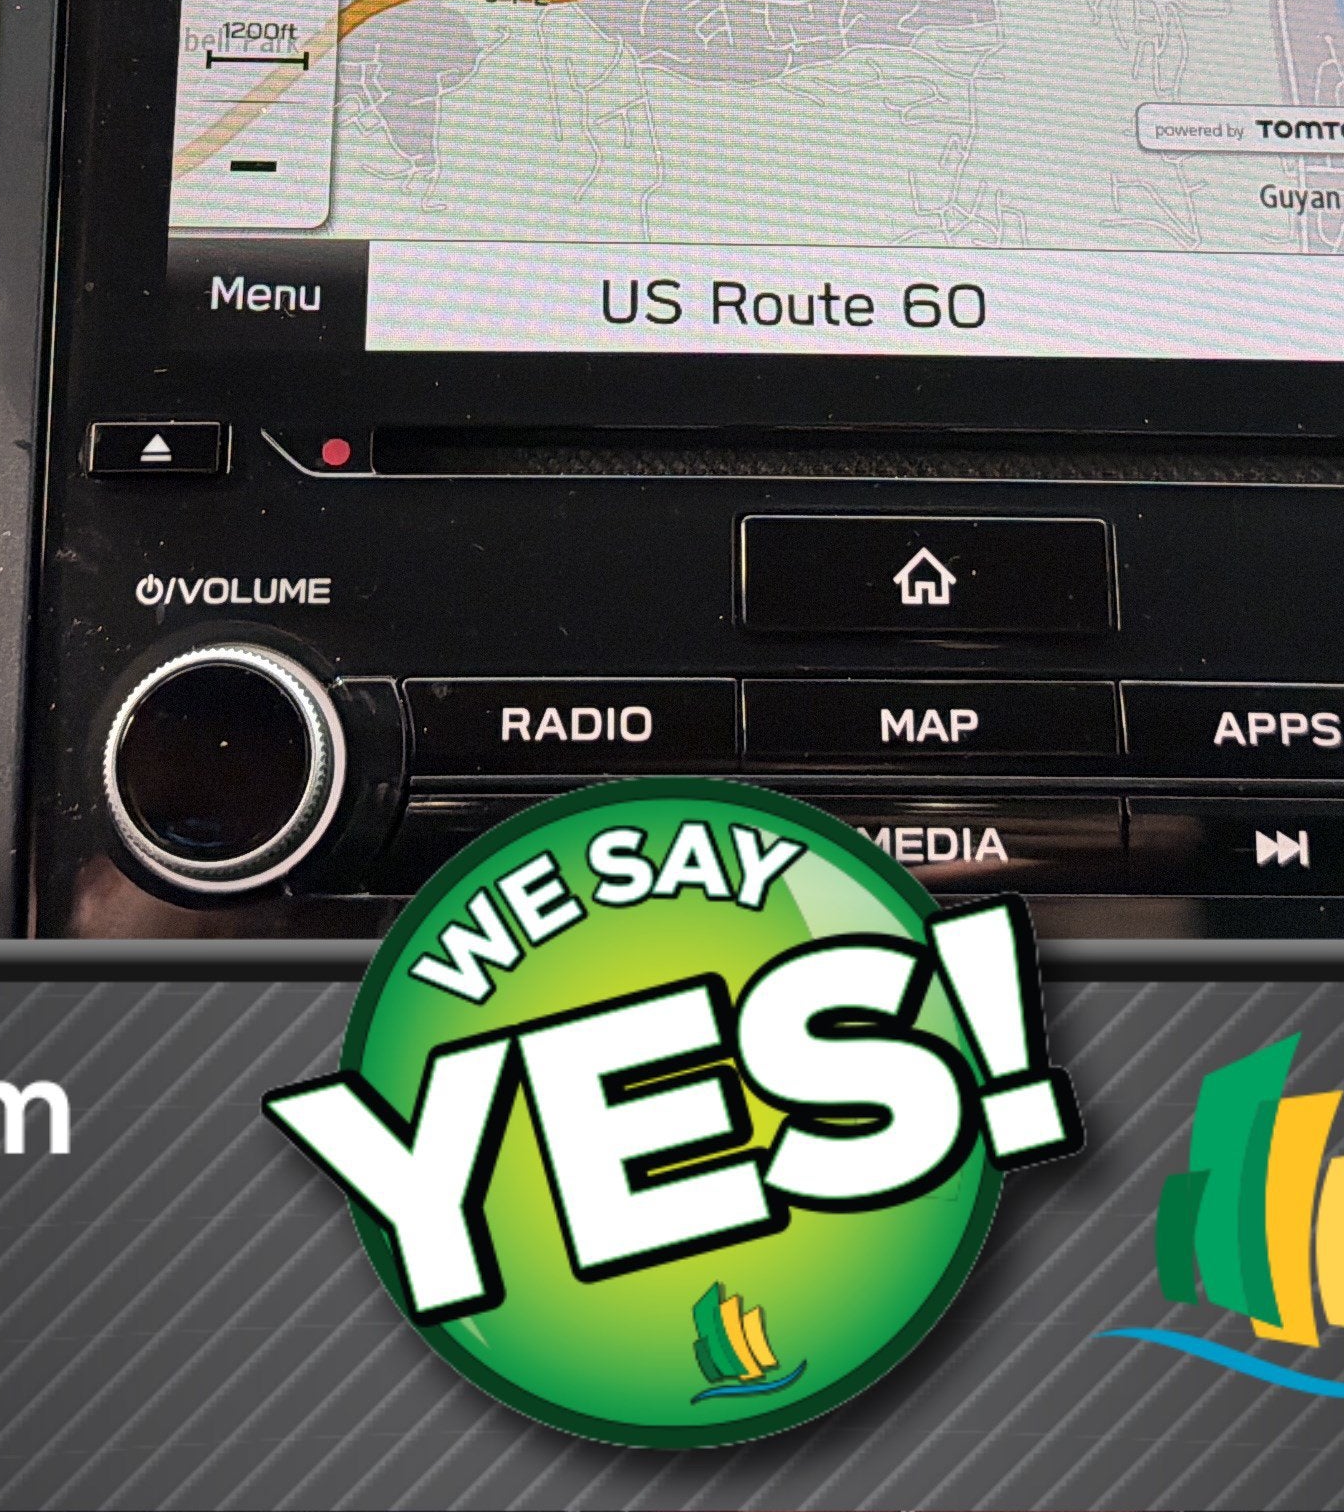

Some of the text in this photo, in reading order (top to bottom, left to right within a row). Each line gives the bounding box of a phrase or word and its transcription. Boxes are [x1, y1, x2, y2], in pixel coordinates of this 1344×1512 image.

[222, 21, 298, 39] 1200ft
[1155, 123, 1223, 139] powered
[1226, 123, 1245, 139] by
[1259, 184, 1341, 215] Guyan
[209, 275, 322, 313] Menu
[600, 280, 987, 331] US Route 60
[501, 705, 653, 742] RADIO
[880, 707, 979, 743] MAP
[1214, 711, 1343, 748] APPS
